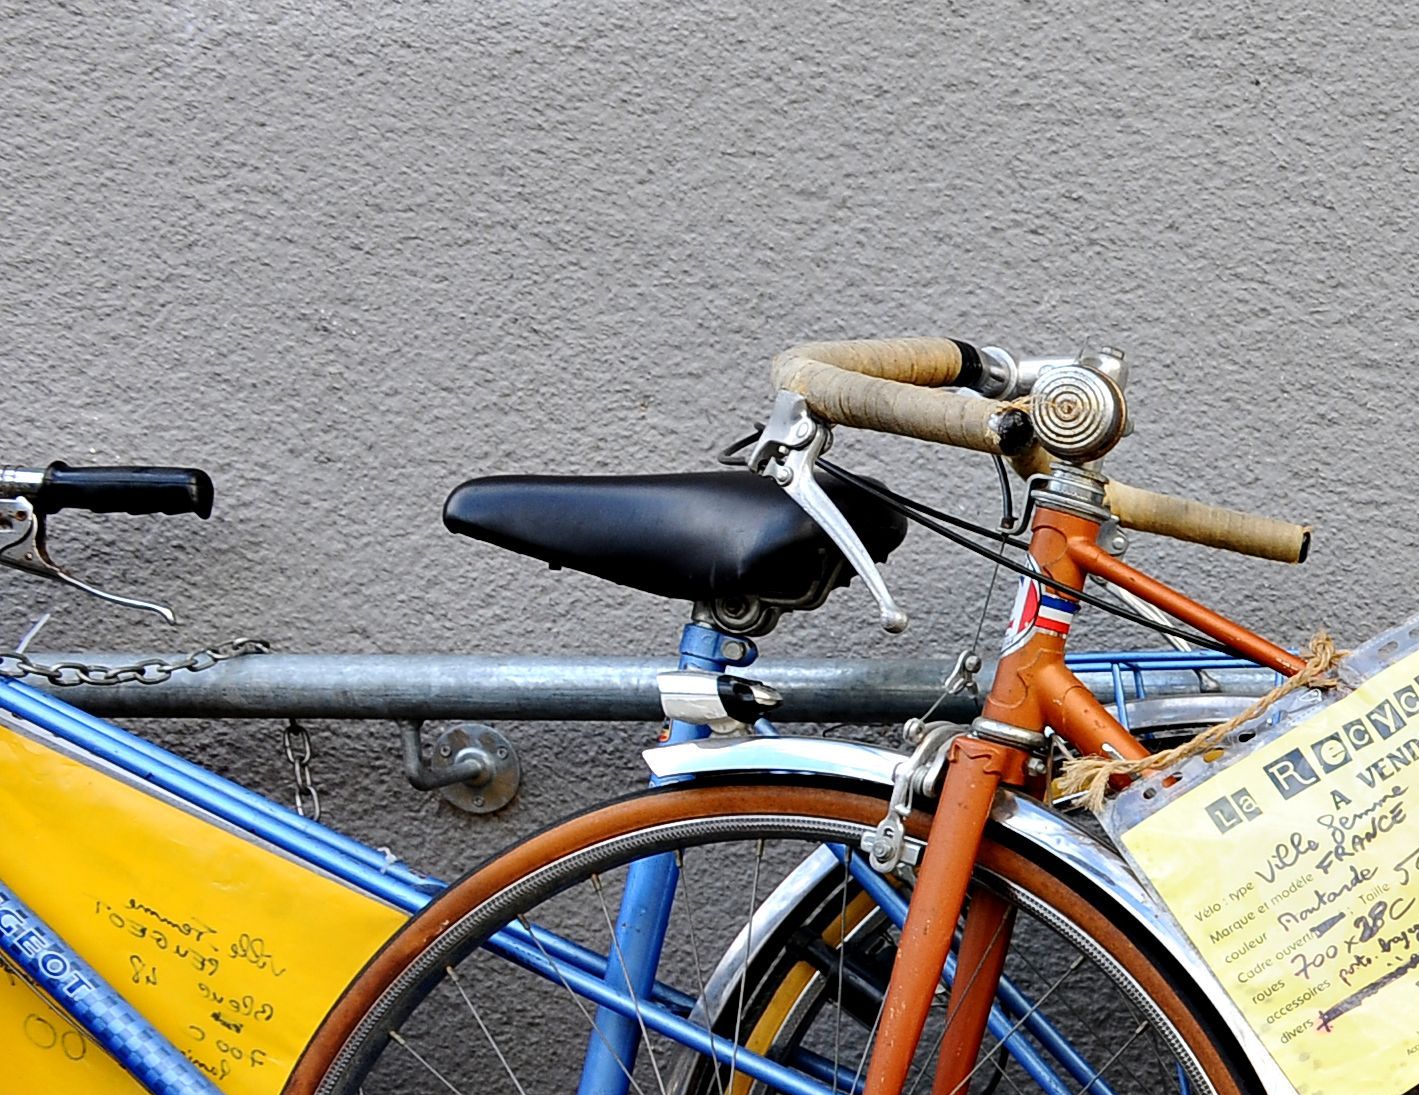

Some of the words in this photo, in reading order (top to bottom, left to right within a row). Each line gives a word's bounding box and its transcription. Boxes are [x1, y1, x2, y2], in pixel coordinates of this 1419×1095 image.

[1329, 789, 1352, 810] A
[1208, 911, 1255, 944] Marque
[1257, 901, 1269, 914] et
[1270, 873, 1314, 905] modèle
[1313, 800, 1407, 874] FRANCE
[1193, 902, 1221, 921] Vélo
[1228, 881, 1254, 901] type
[0, 906, 97, 1000] GEOT
[1224, 932, 1267, 963] couleur
[1236, 958, 1272, 983] Cadre
[1357, 883, 1390, 905] Taille
[1251, 979, 1285, 1004] roues
[1265, 979, 1331, 1024] accessoires
[1280, 1018, 1314, 1044] divers
